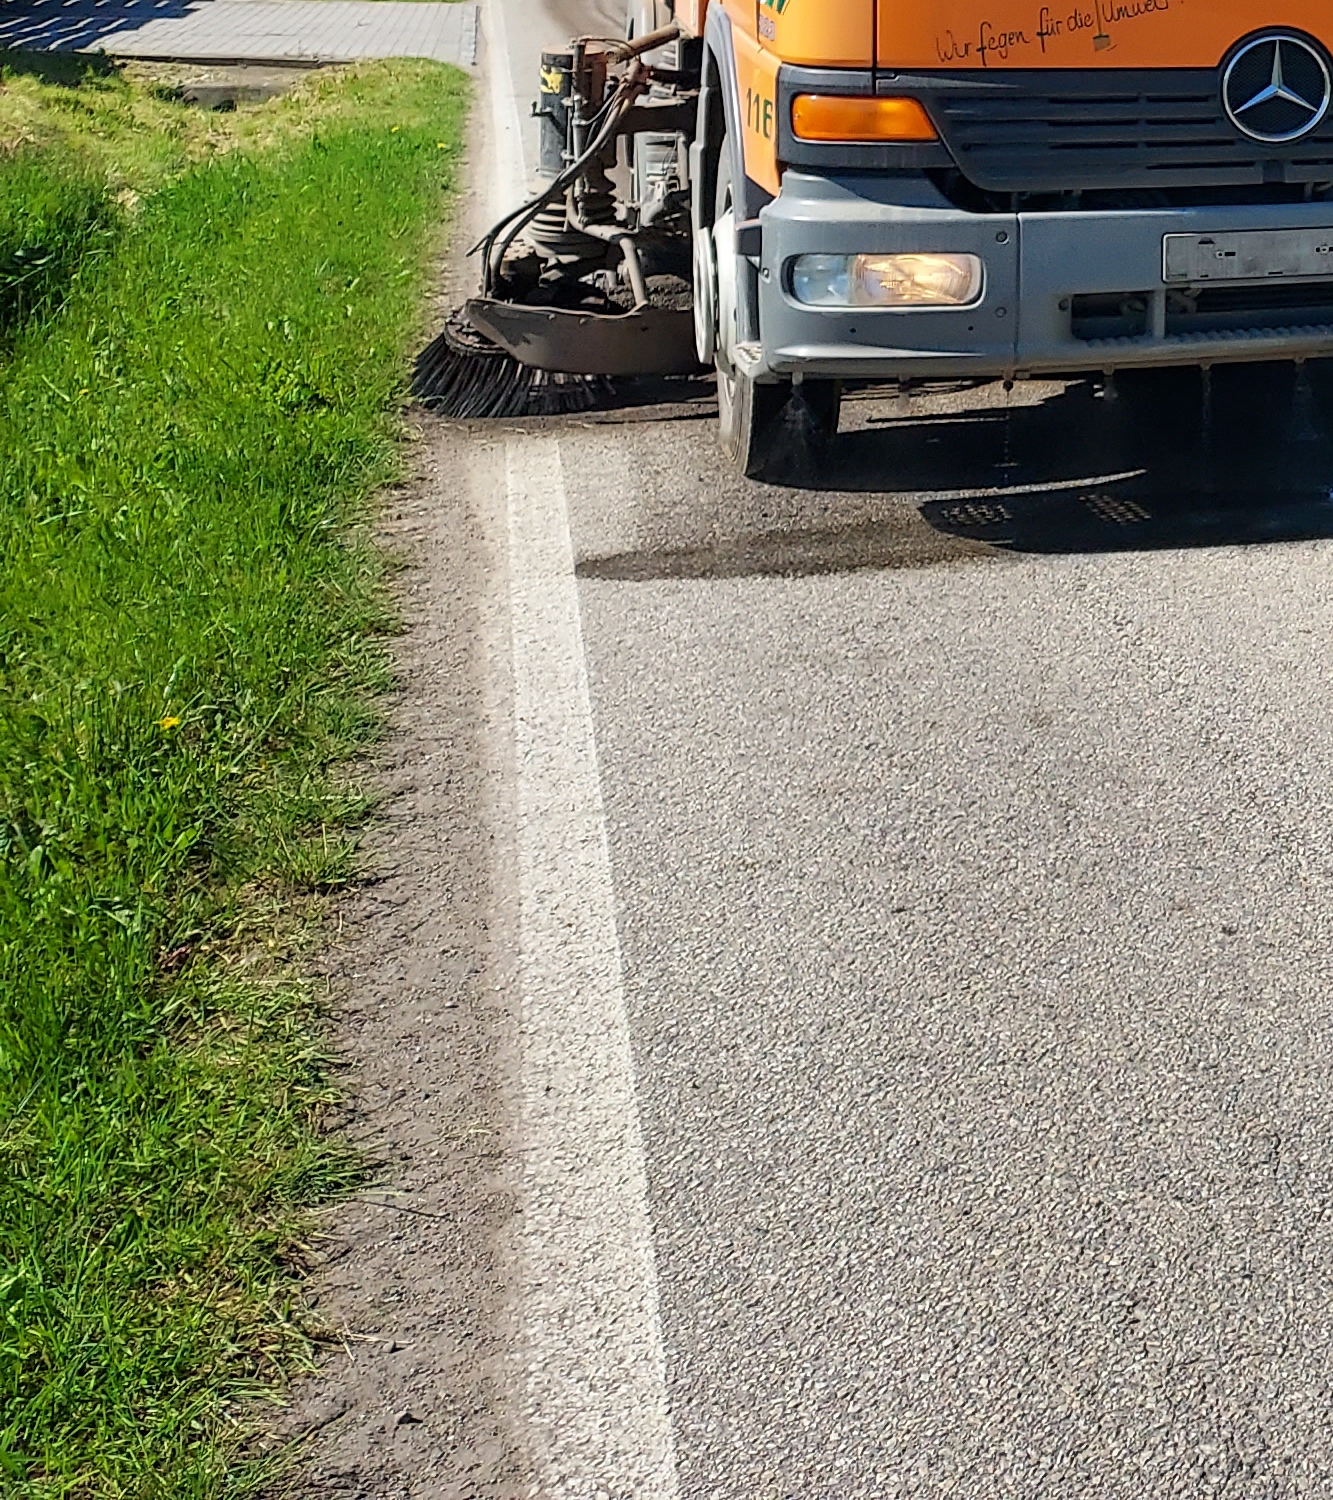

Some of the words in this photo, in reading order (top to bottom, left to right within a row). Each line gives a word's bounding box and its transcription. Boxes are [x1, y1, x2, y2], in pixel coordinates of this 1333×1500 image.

[935, 30, 972, 63] Wir
[976, 21, 1030, 67] fegen
[1036, 7, 1063, 53] für
[1067, 8, 1094, 33] die
